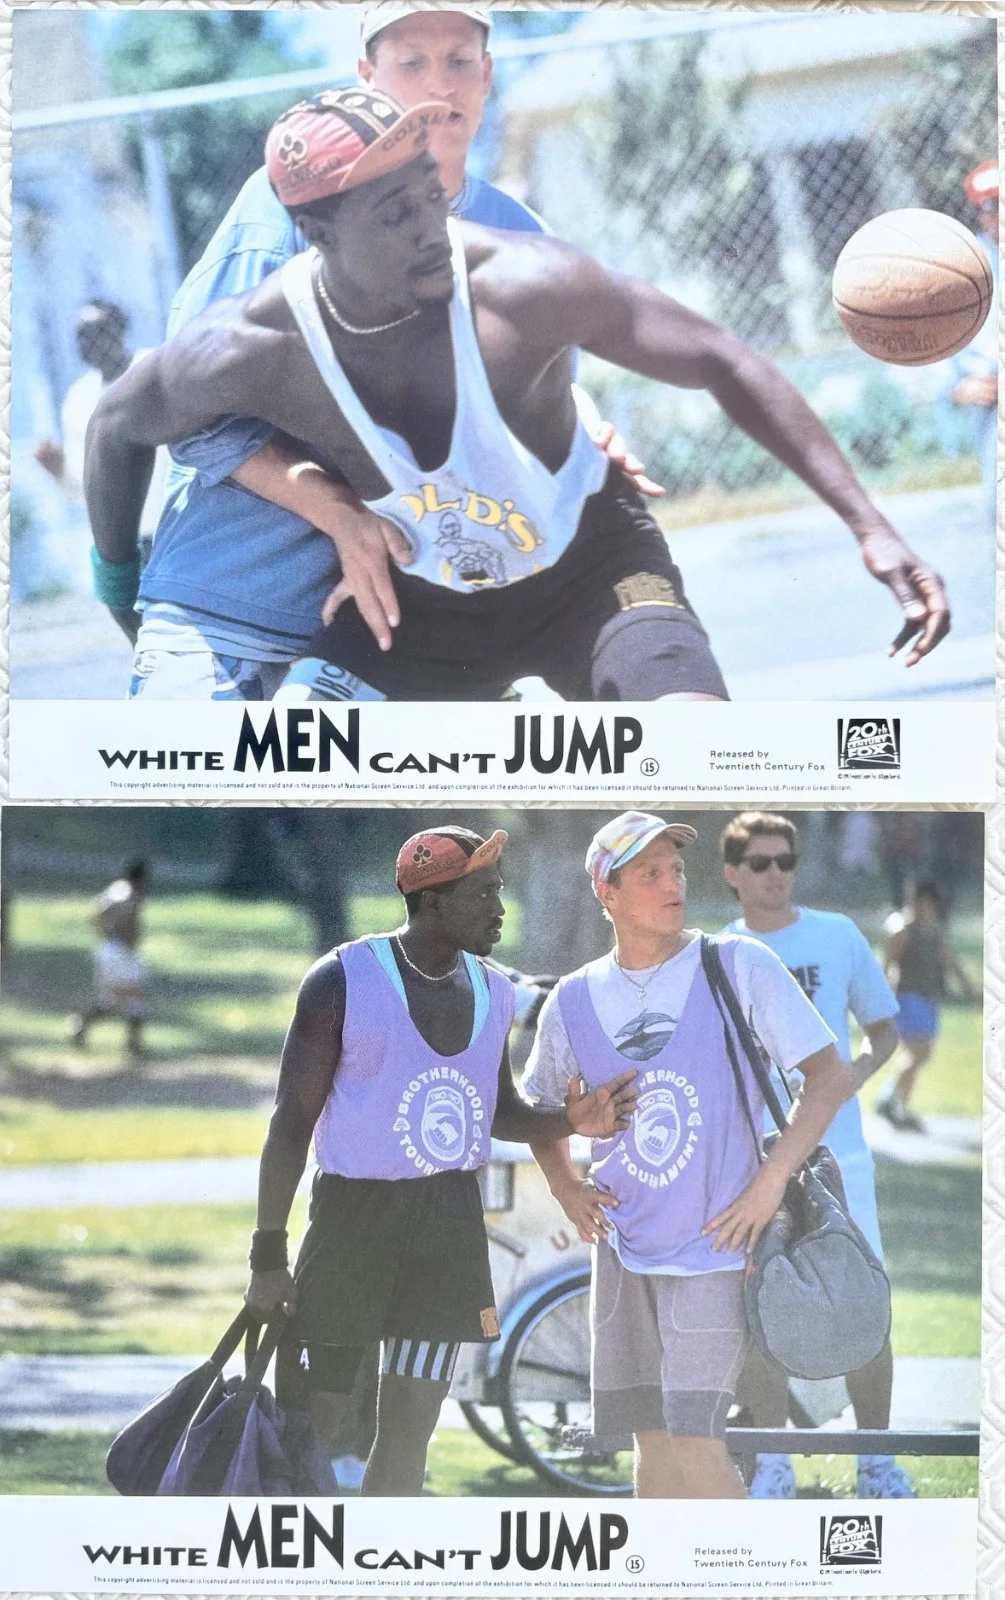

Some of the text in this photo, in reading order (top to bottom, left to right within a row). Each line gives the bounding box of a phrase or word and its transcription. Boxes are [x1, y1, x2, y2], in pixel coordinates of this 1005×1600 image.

[848, 721, 888, 742] 20th
[98, 707, 643, 775] WHITE MEN CAN'T JUMP
[710, 749, 769, 759] Released by
[848, 743, 887, 758] FOX
[709, 762, 825, 772] Twentieth Century Fox
[123, 782, 152, 790] copyright
[152, 782, 186, 790] advertising
[398, 1066, 484, 1120] BROTHERHOOD
[830, 1519, 870, 1539] 20th
[82, 1503, 629, 1572] WHITE MEN CAN'T JUMP
[694, 1547, 753, 1556] Released by
[830, 1540, 869, 1554] FOX
[694, 1559, 808, 1569] Twentieth Century Fox
[107, 1576, 135, 1585] copyright
[136, 1577, 169, 1585] advertising
